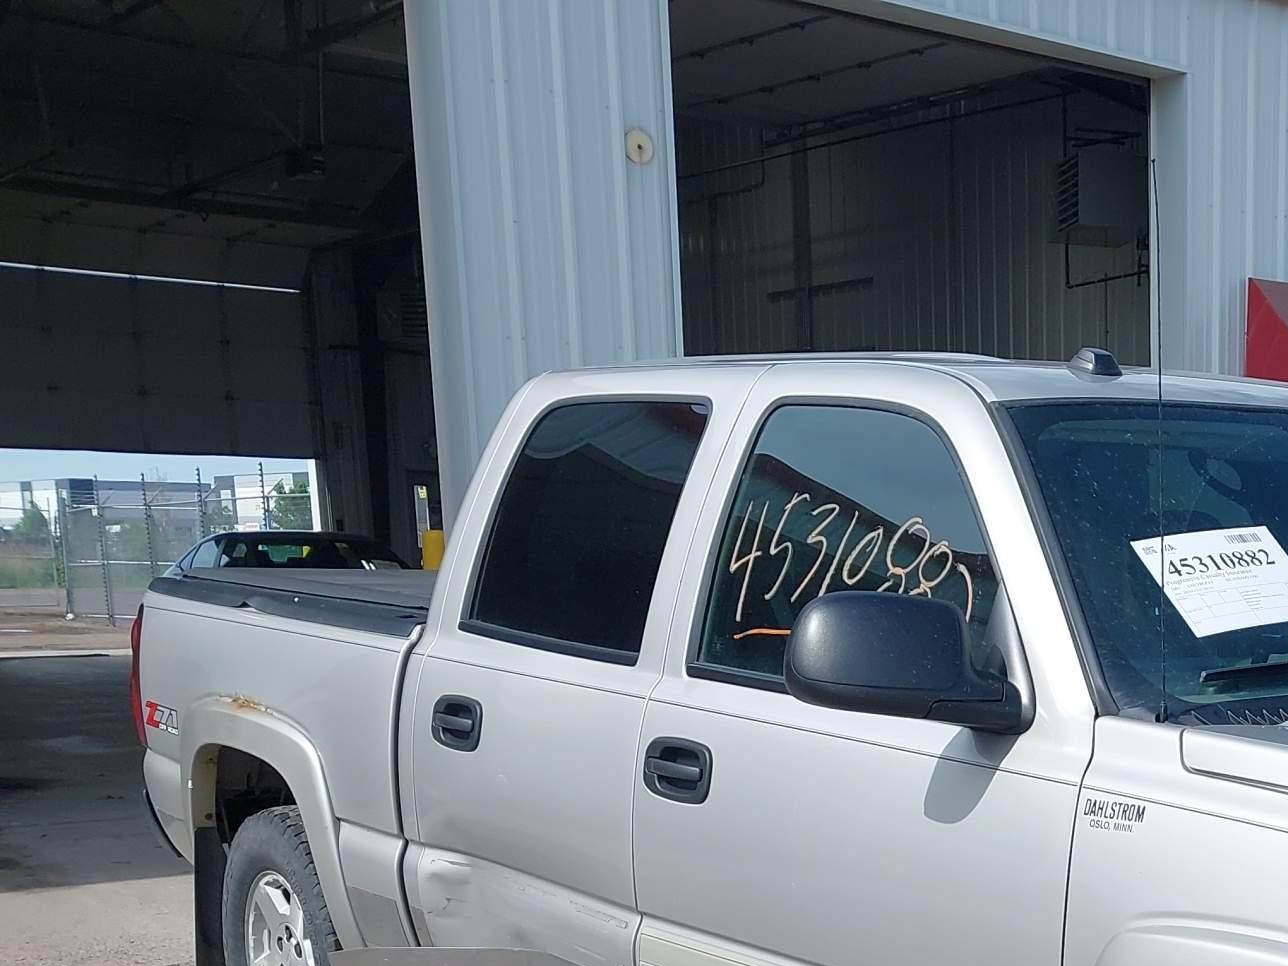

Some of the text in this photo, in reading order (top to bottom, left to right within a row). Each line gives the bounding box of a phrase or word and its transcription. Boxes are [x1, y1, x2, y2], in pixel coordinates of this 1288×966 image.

[1167, 549, 1276, 577] 45310882
[145, 701, 179, 729] Z71
[1084, 798, 1146, 823] DAHLSTROM
[1089, 819, 1134, 833] OSLO, MINN.
